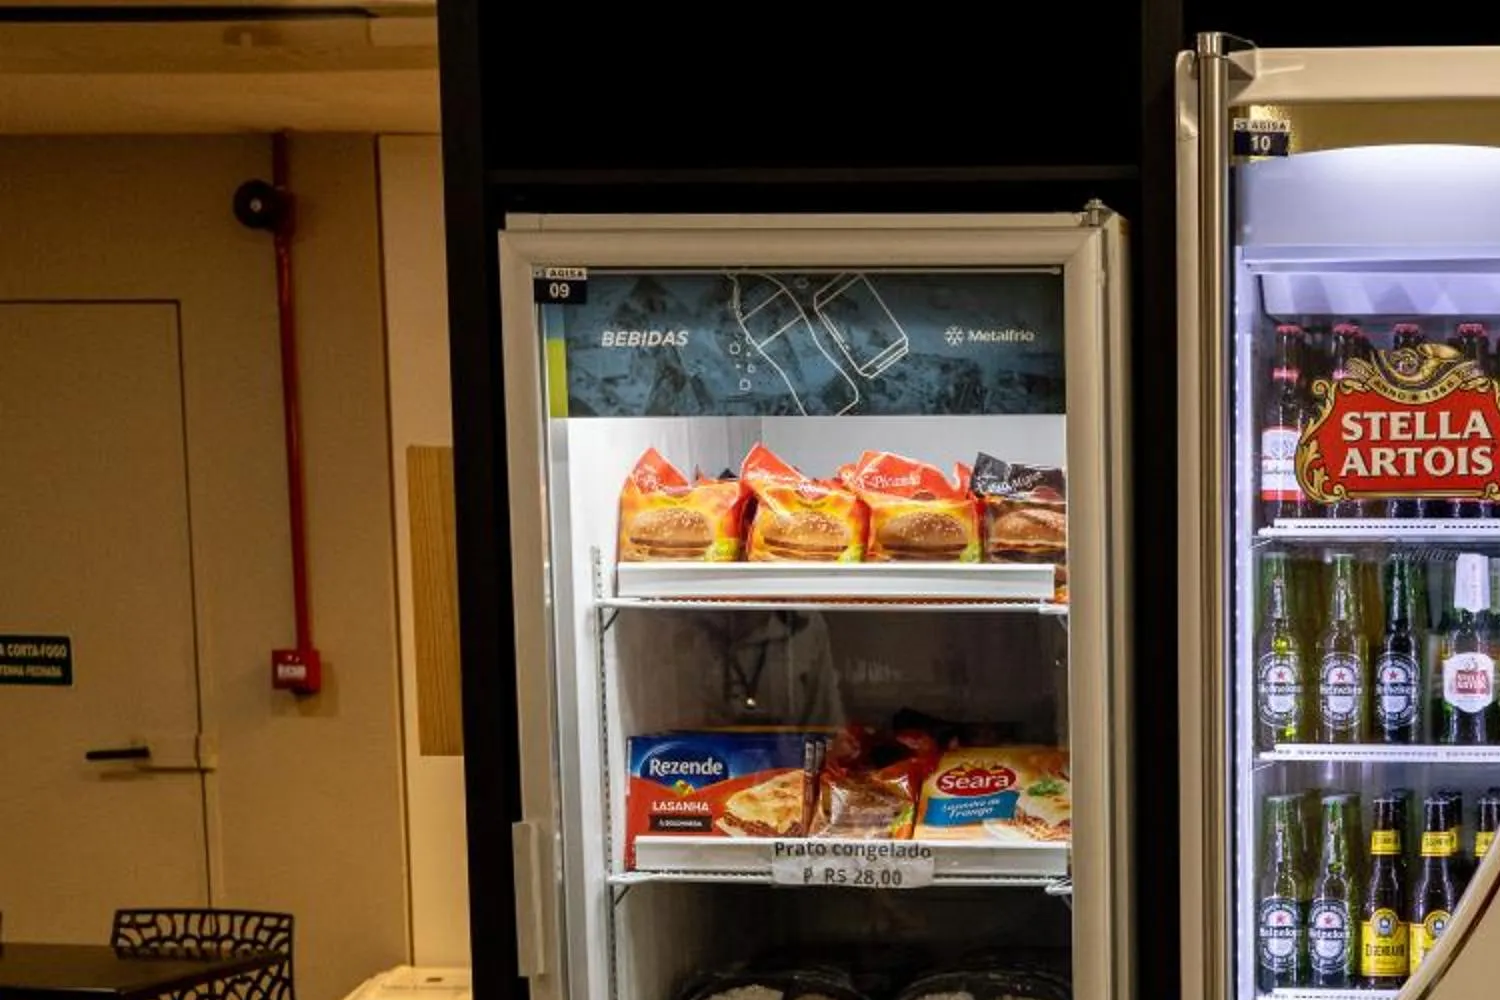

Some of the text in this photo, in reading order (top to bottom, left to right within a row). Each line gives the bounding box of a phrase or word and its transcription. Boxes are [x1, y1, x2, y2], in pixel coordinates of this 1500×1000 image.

[1251, 135, 1271, 151] 10
[549, 282, 570, 299] 09
[601, 330, 689, 348] BEBIDAS
[967, 328, 1036, 343] Metalfrio
[1340, 409, 1493, 442] STELLA
[1339, 446, 1494, 478] ARTOIS
[650, 757, 723, 776] Rezende
[940, 774, 1010, 790] Seara
[651, 801, 710, 812] LASANHA
[774, 841, 931, 862] Prato congelado
[853, 869, 903, 888] 28,00
